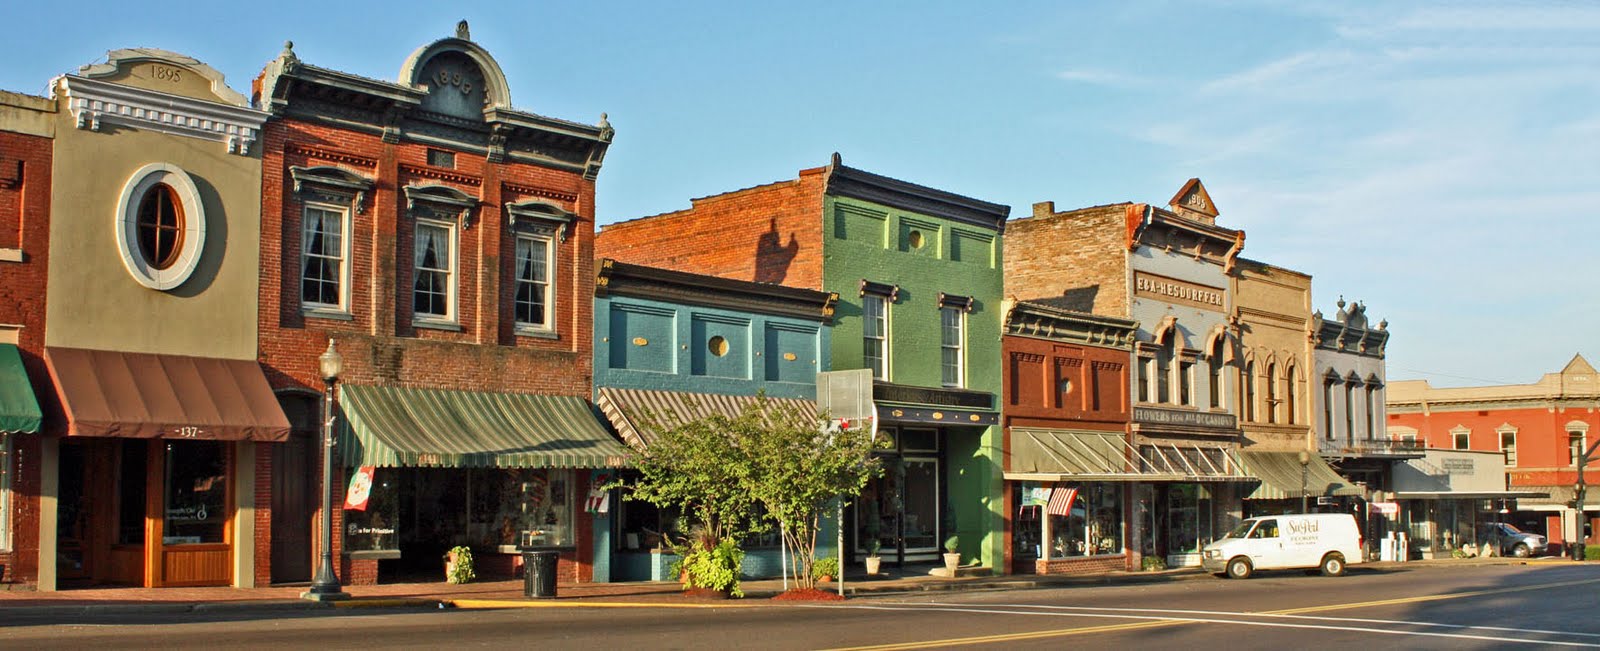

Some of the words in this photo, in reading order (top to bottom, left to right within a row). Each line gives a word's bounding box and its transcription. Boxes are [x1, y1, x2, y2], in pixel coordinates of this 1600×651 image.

[151, 64, 182, 83] 1895
[431, 70, 473, 95] 1893
[1135, 409, 1170, 423] FLOWERS
[1171, 413, 1184, 423] FOR
[1196, 413, 1234, 427] OCCASIONS
